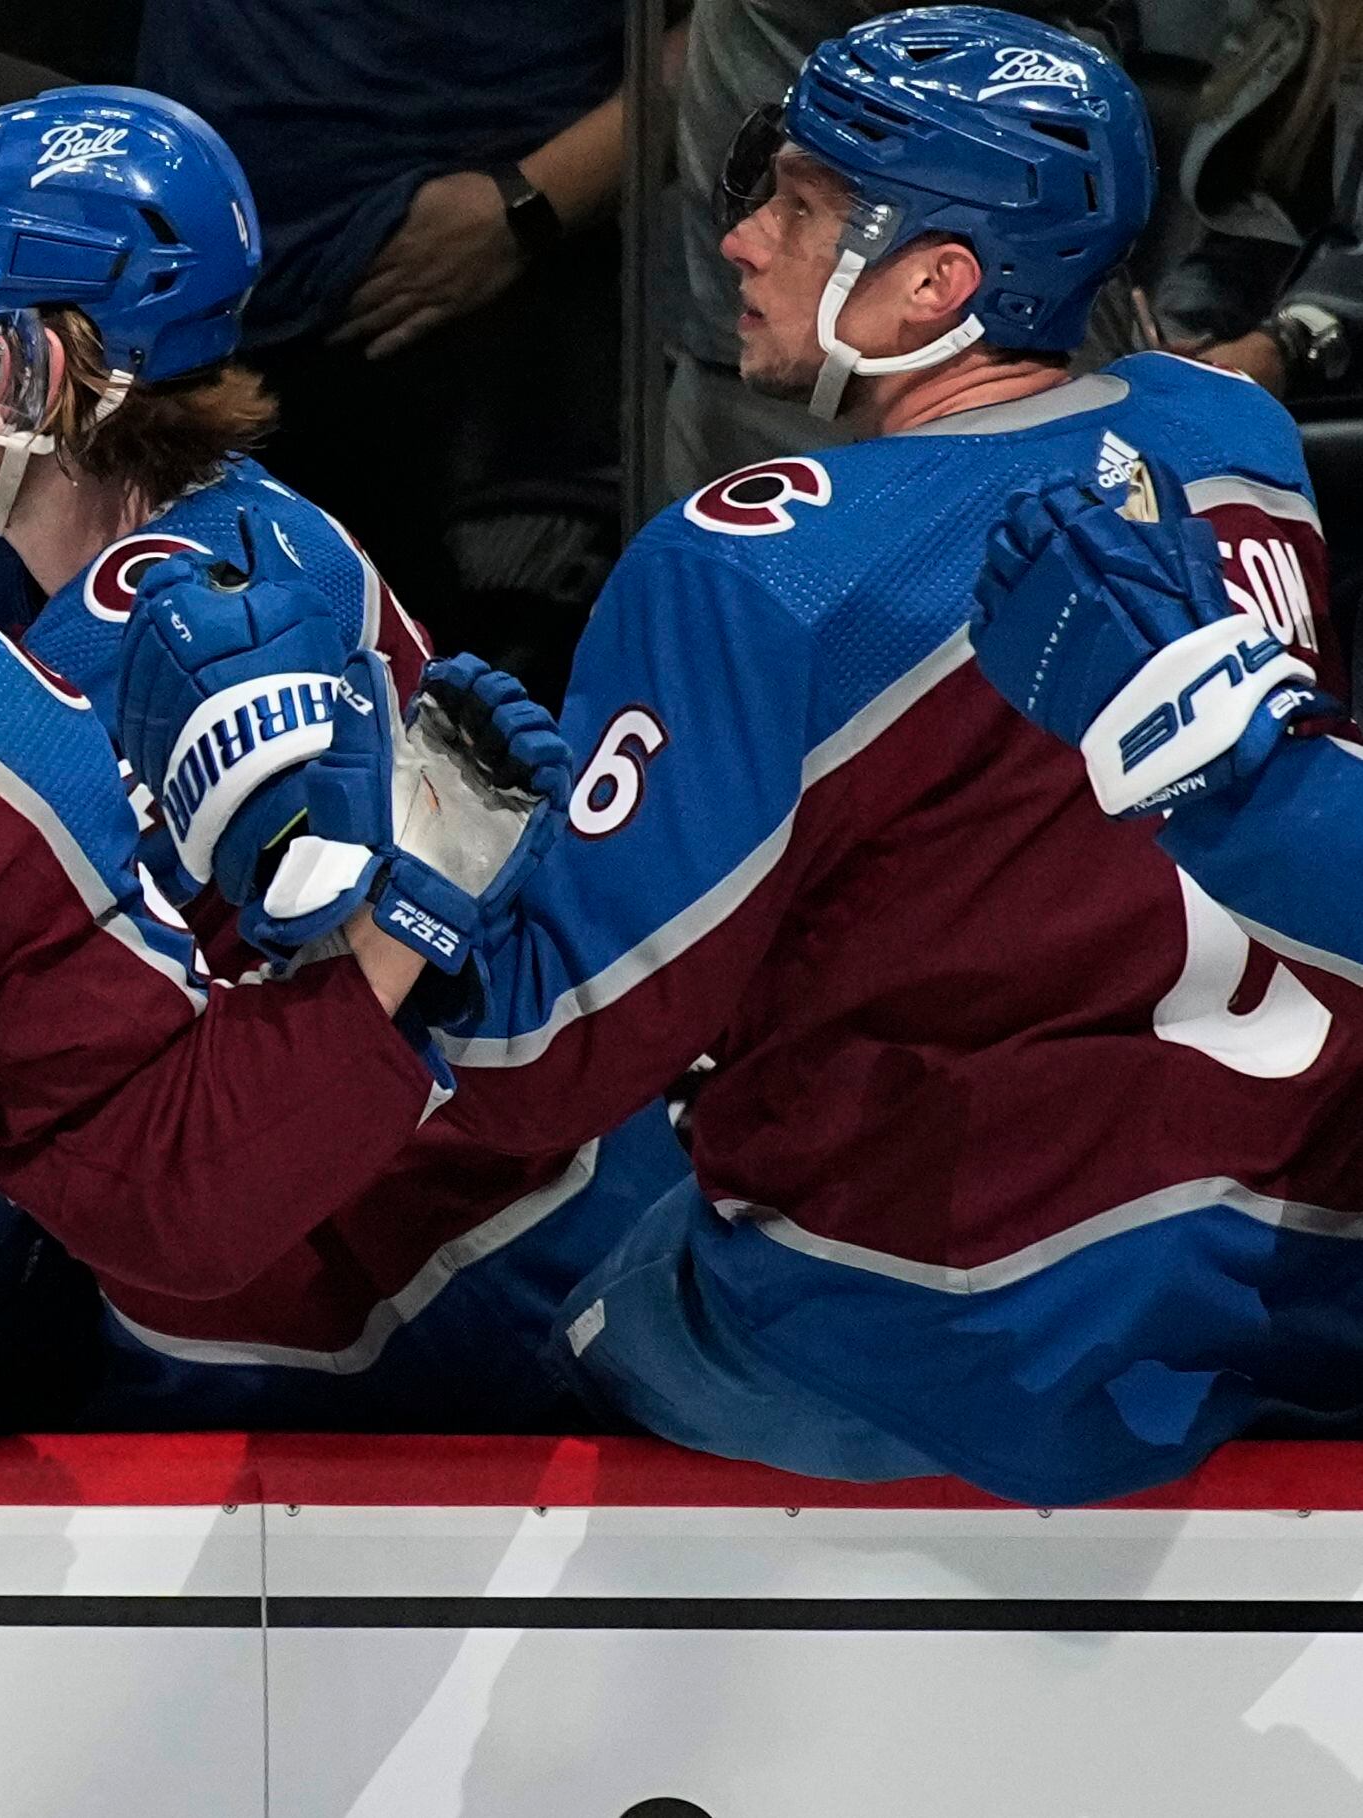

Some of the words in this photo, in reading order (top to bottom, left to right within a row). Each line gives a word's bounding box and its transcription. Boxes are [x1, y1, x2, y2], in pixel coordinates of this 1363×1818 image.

[978, 46, 1087, 98] Ball
[31, 122, 129, 186] Ball
[1119, 632, 1286, 776] RUE
[162, 681, 334, 844] ARRIOR
[567, 704, 669, 842] 6
[389, 909, 456, 957] CCM
[415, 910, 443, 932] PRO
